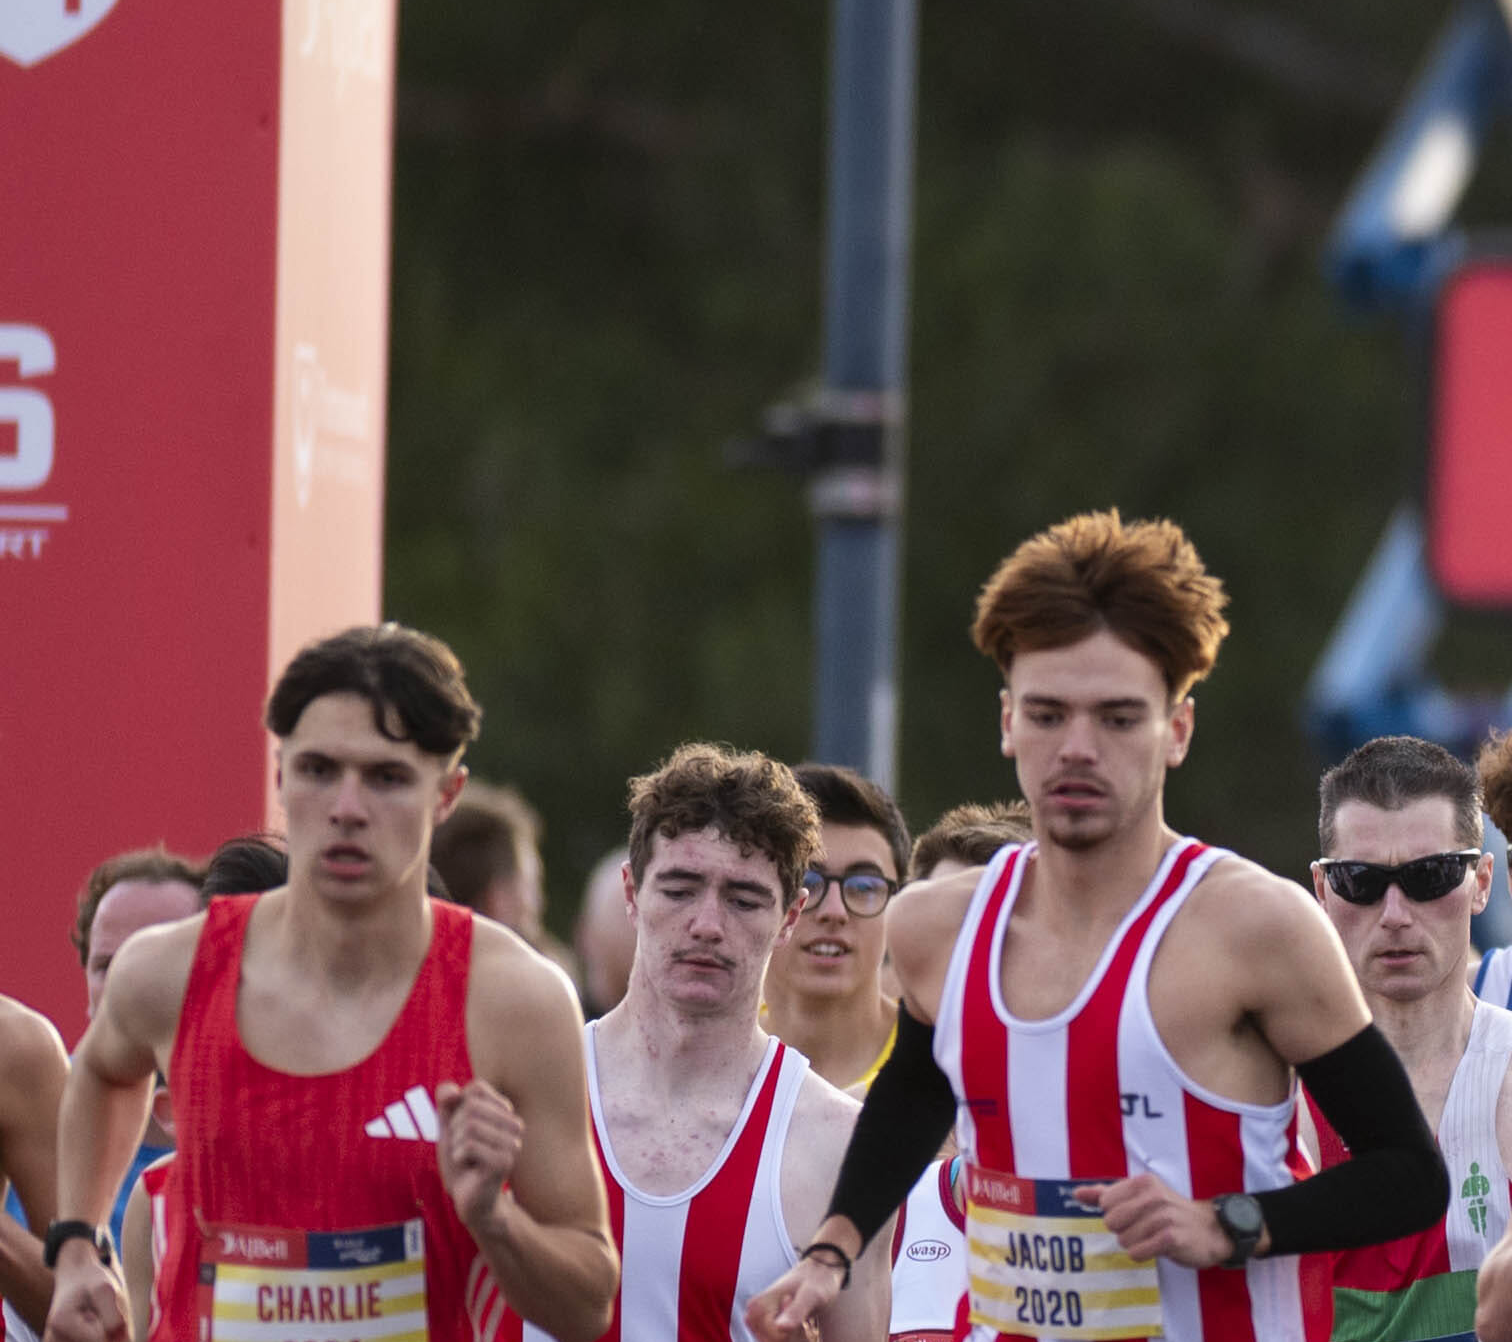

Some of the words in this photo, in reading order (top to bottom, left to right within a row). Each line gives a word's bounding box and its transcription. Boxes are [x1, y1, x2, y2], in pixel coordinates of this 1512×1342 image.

[1121, 1093, 1164, 1119] JL
[911, 1245, 948, 1257] wasp
[1005, 1232, 1085, 1273] JACOB
[256, 1280, 384, 1322] CHARLIE
[1014, 1285, 1084, 1328] 2020
